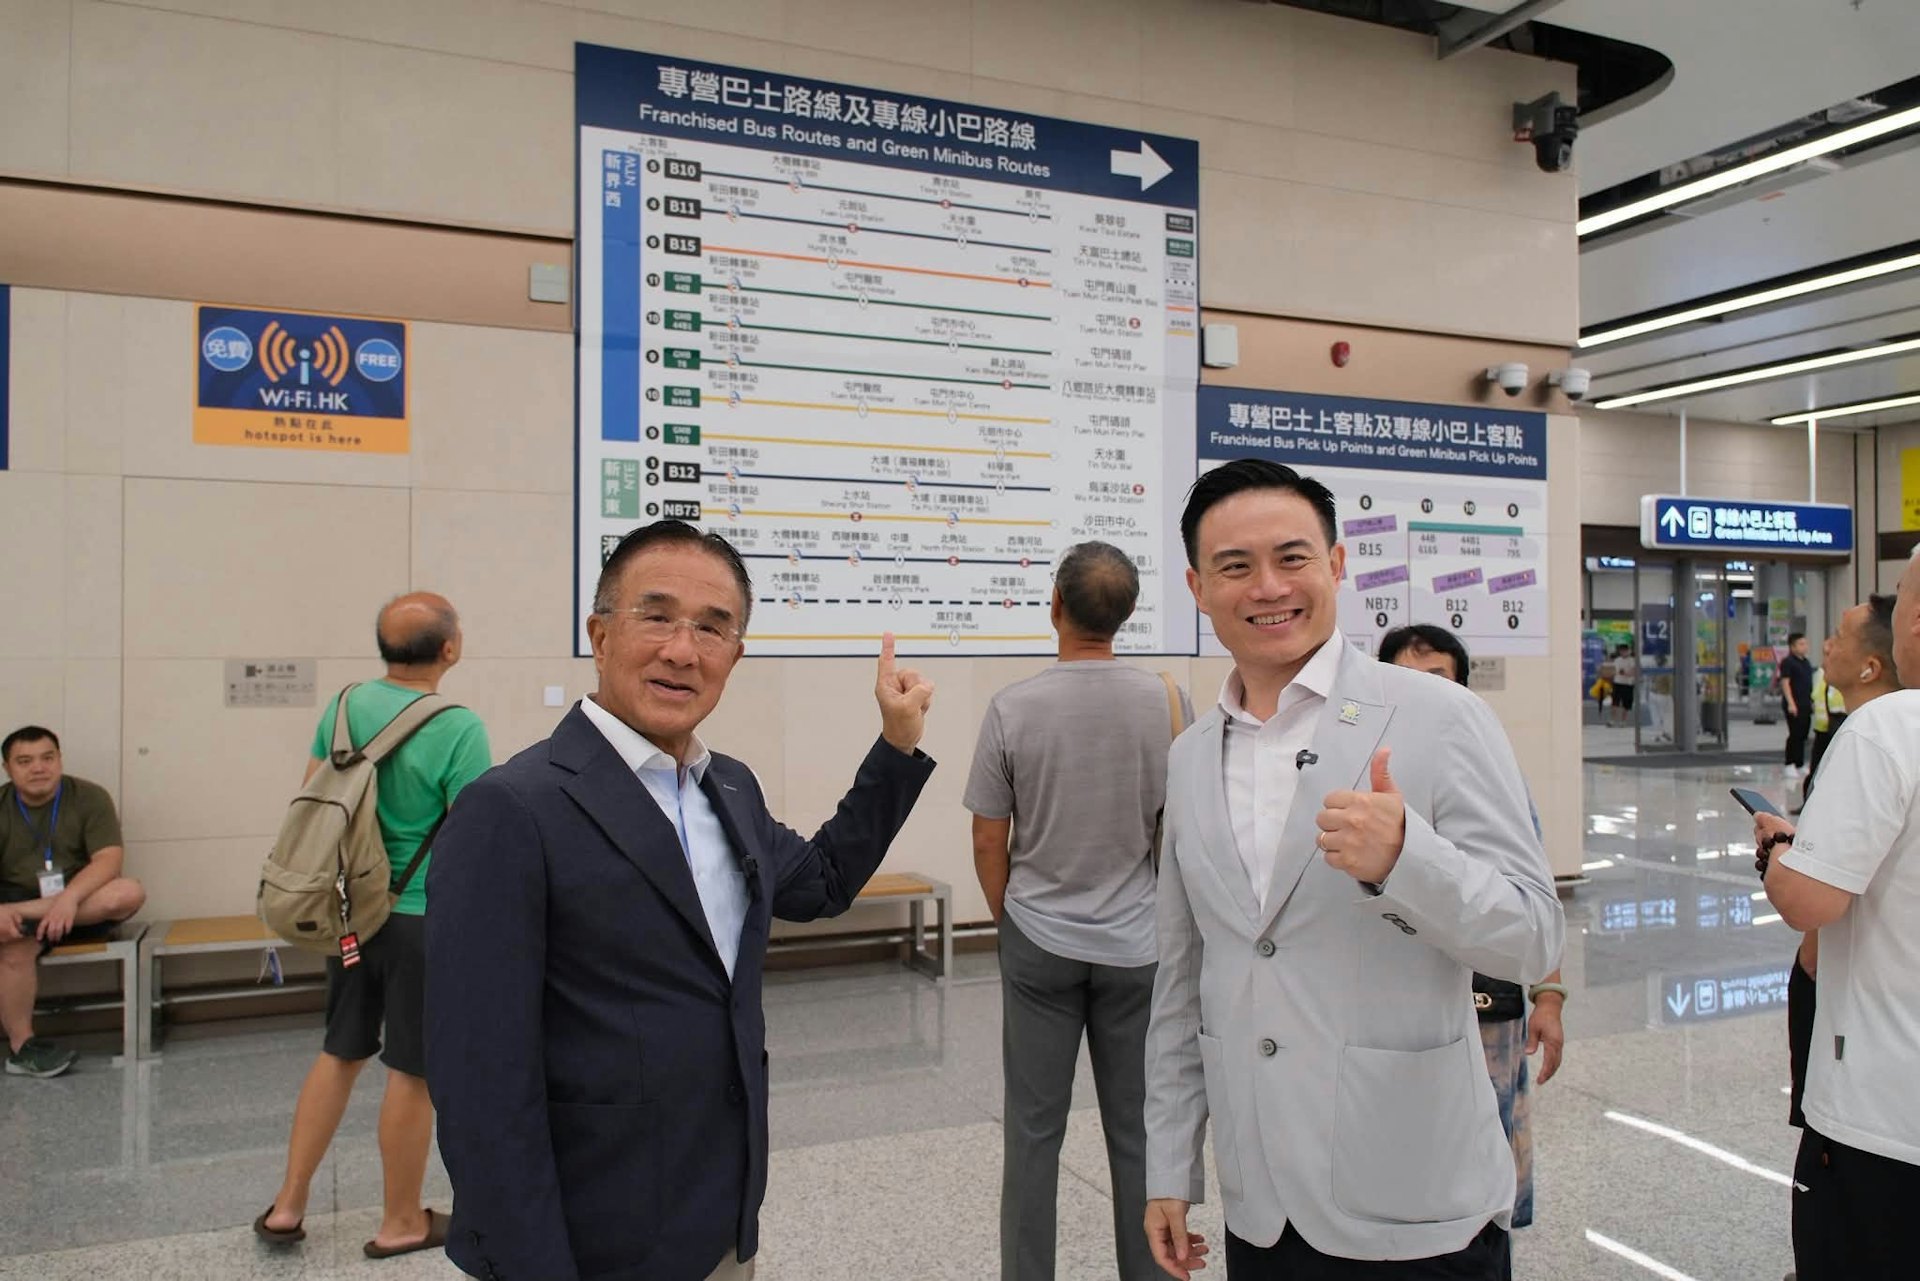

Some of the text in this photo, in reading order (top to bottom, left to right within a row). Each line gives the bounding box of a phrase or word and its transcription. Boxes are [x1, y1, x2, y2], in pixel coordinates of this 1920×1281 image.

[657, 65, 1037, 150] 專營巴士路線及專線小巴路線
[639, 103, 1051, 178] Franchised Bus Routes and Green Minibus Routes
[669, 162, 697, 178] B10
[669, 200, 696, 215] B11
[669, 237, 697, 253] B15
[207, 338, 251, 360] 免費
[359, 352, 397, 368] FREE
[258, 387, 350, 411] Wi-Fi.HK
[1228, 402, 1523, 449] 專營巴士上客點及專線小巴上客點
[244, 429, 362, 446] hotspot is here
[1210, 431, 1538, 467] Franchised Bus Pick Up Points and Green Minibus Pick Up Points
[668, 465, 696, 479] B12
[664, 503, 700, 518] NB73
[1714, 526, 1742, 540] Green
[1798, 530, 1811, 545] Up
[1811, 530, 1833, 543] Area
[1358, 542, 1382, 557] B15
[1365, 597, 1398, 611] NB73
[1446, 598, 1468, 612] B12
[1502, 600, 1524, 613] B12
[1646, 620, 1667, 639] L2
